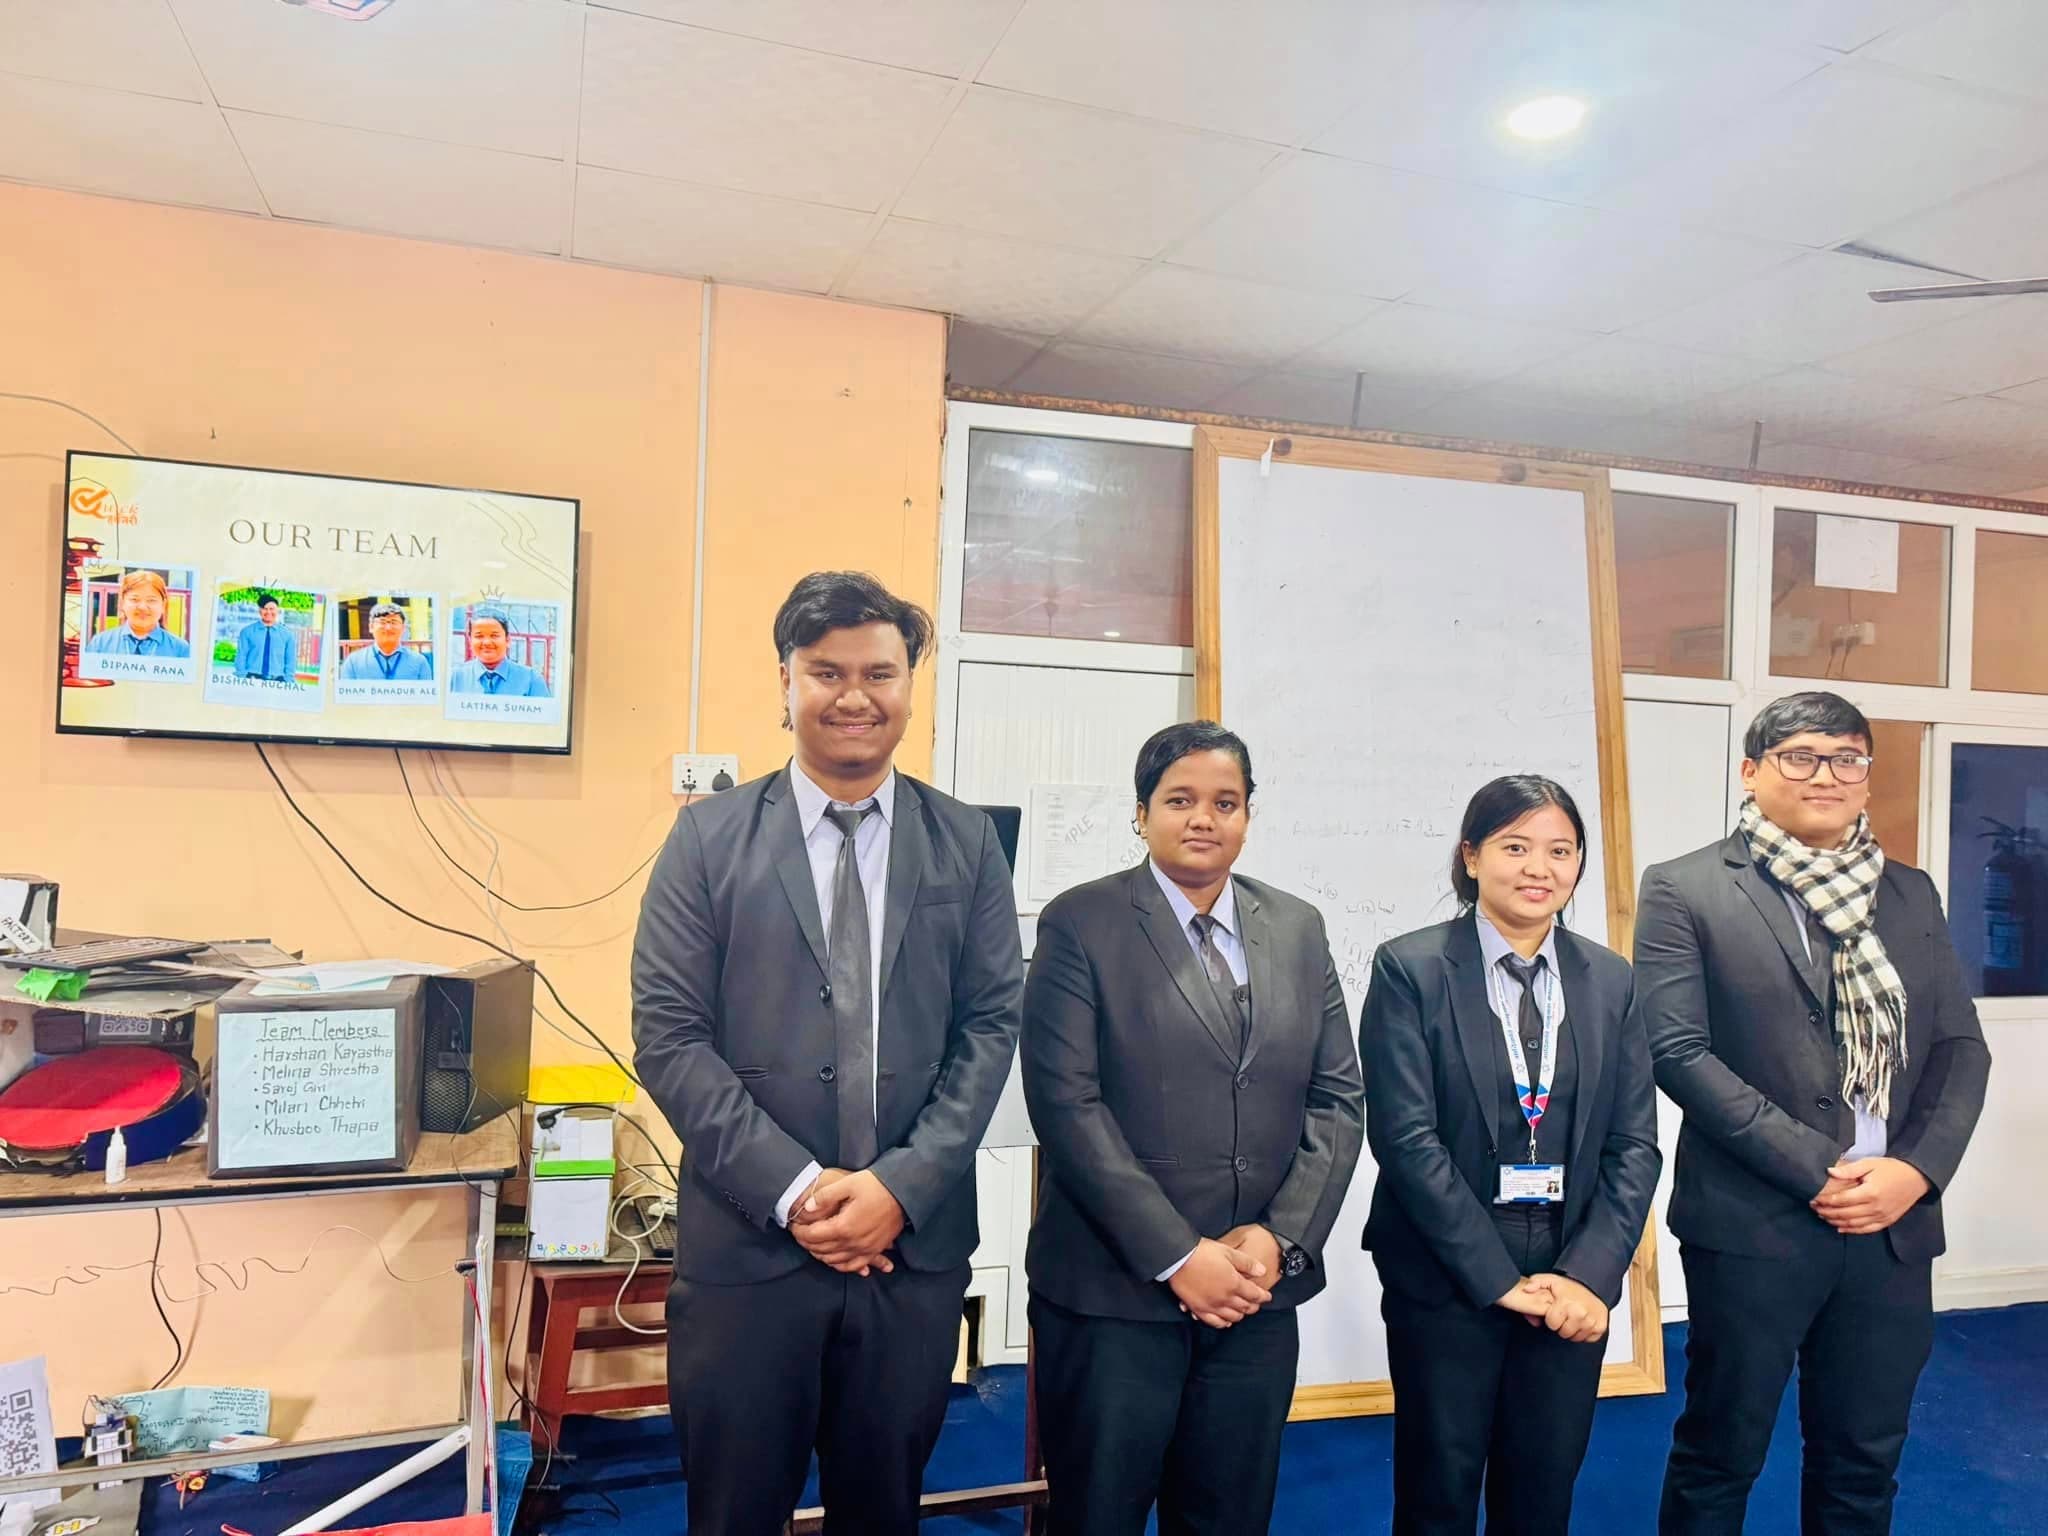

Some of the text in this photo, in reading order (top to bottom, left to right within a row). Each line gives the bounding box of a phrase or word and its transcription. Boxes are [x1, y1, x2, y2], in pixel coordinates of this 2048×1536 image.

[229, 519, 439, 559] OUR TEAM
[101, 659, 185, 677] BIPANA RANA
[212, 674, 256, 687] BISHAL
[339, 687, 436, 696] DHAN BAHADUR ALE
[461, 701, 542, 713] LATIKA SUNAM
[261, 1016, 378, 1040] Team Members
[320, 1062, 380, 1077] Shrestha
[261, 1082, 298, 1096] Saroj
[330, 1115, 380, 1138] Thapa
